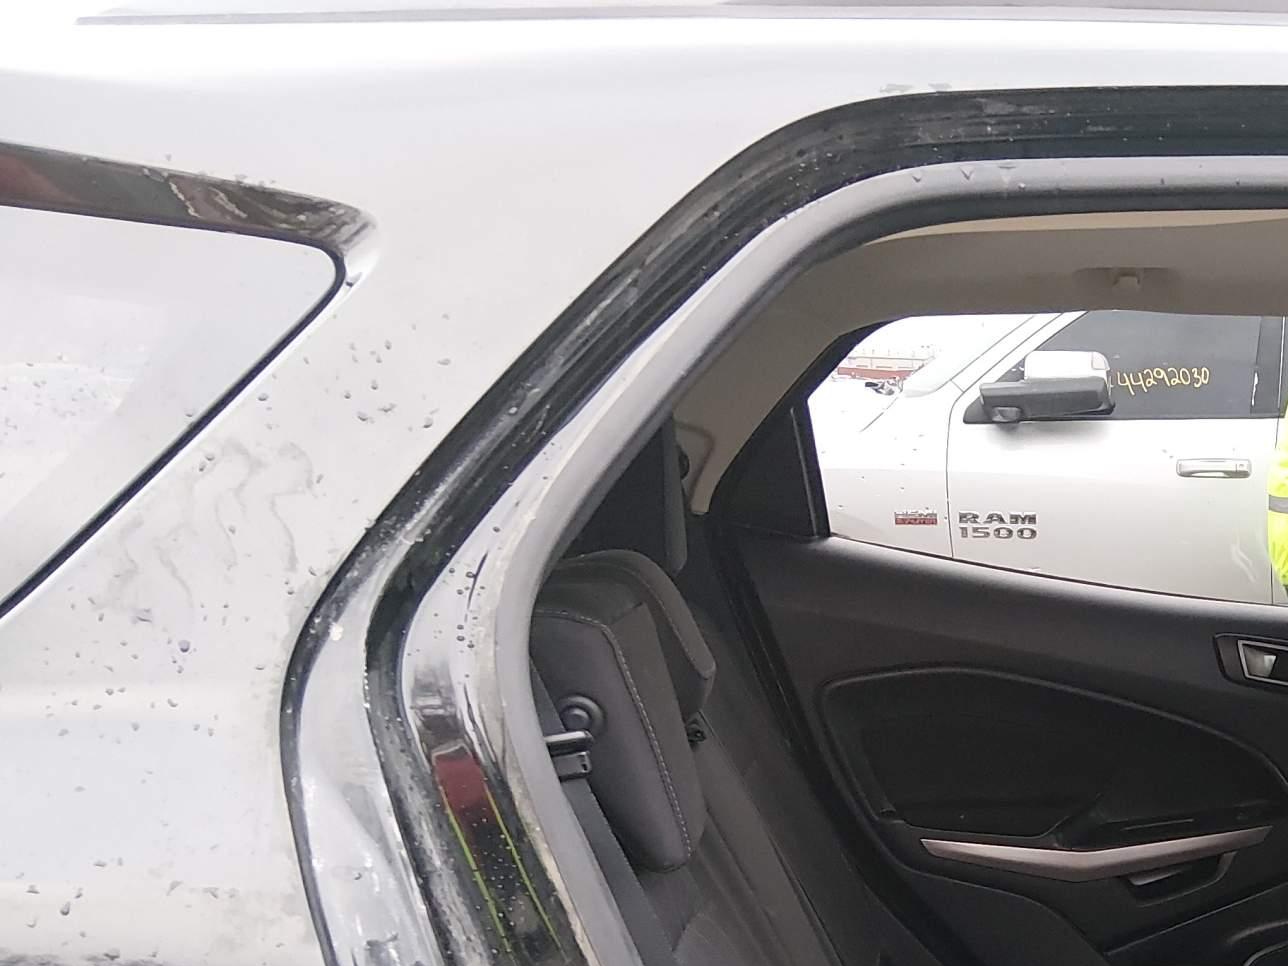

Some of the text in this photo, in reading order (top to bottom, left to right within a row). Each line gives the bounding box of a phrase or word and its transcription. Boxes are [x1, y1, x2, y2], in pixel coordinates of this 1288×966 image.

[1116, 366, 1210, 395] 44292030
[958, 511, 1037, 525] RAM
[958, 526, 1038, 540] 1500
